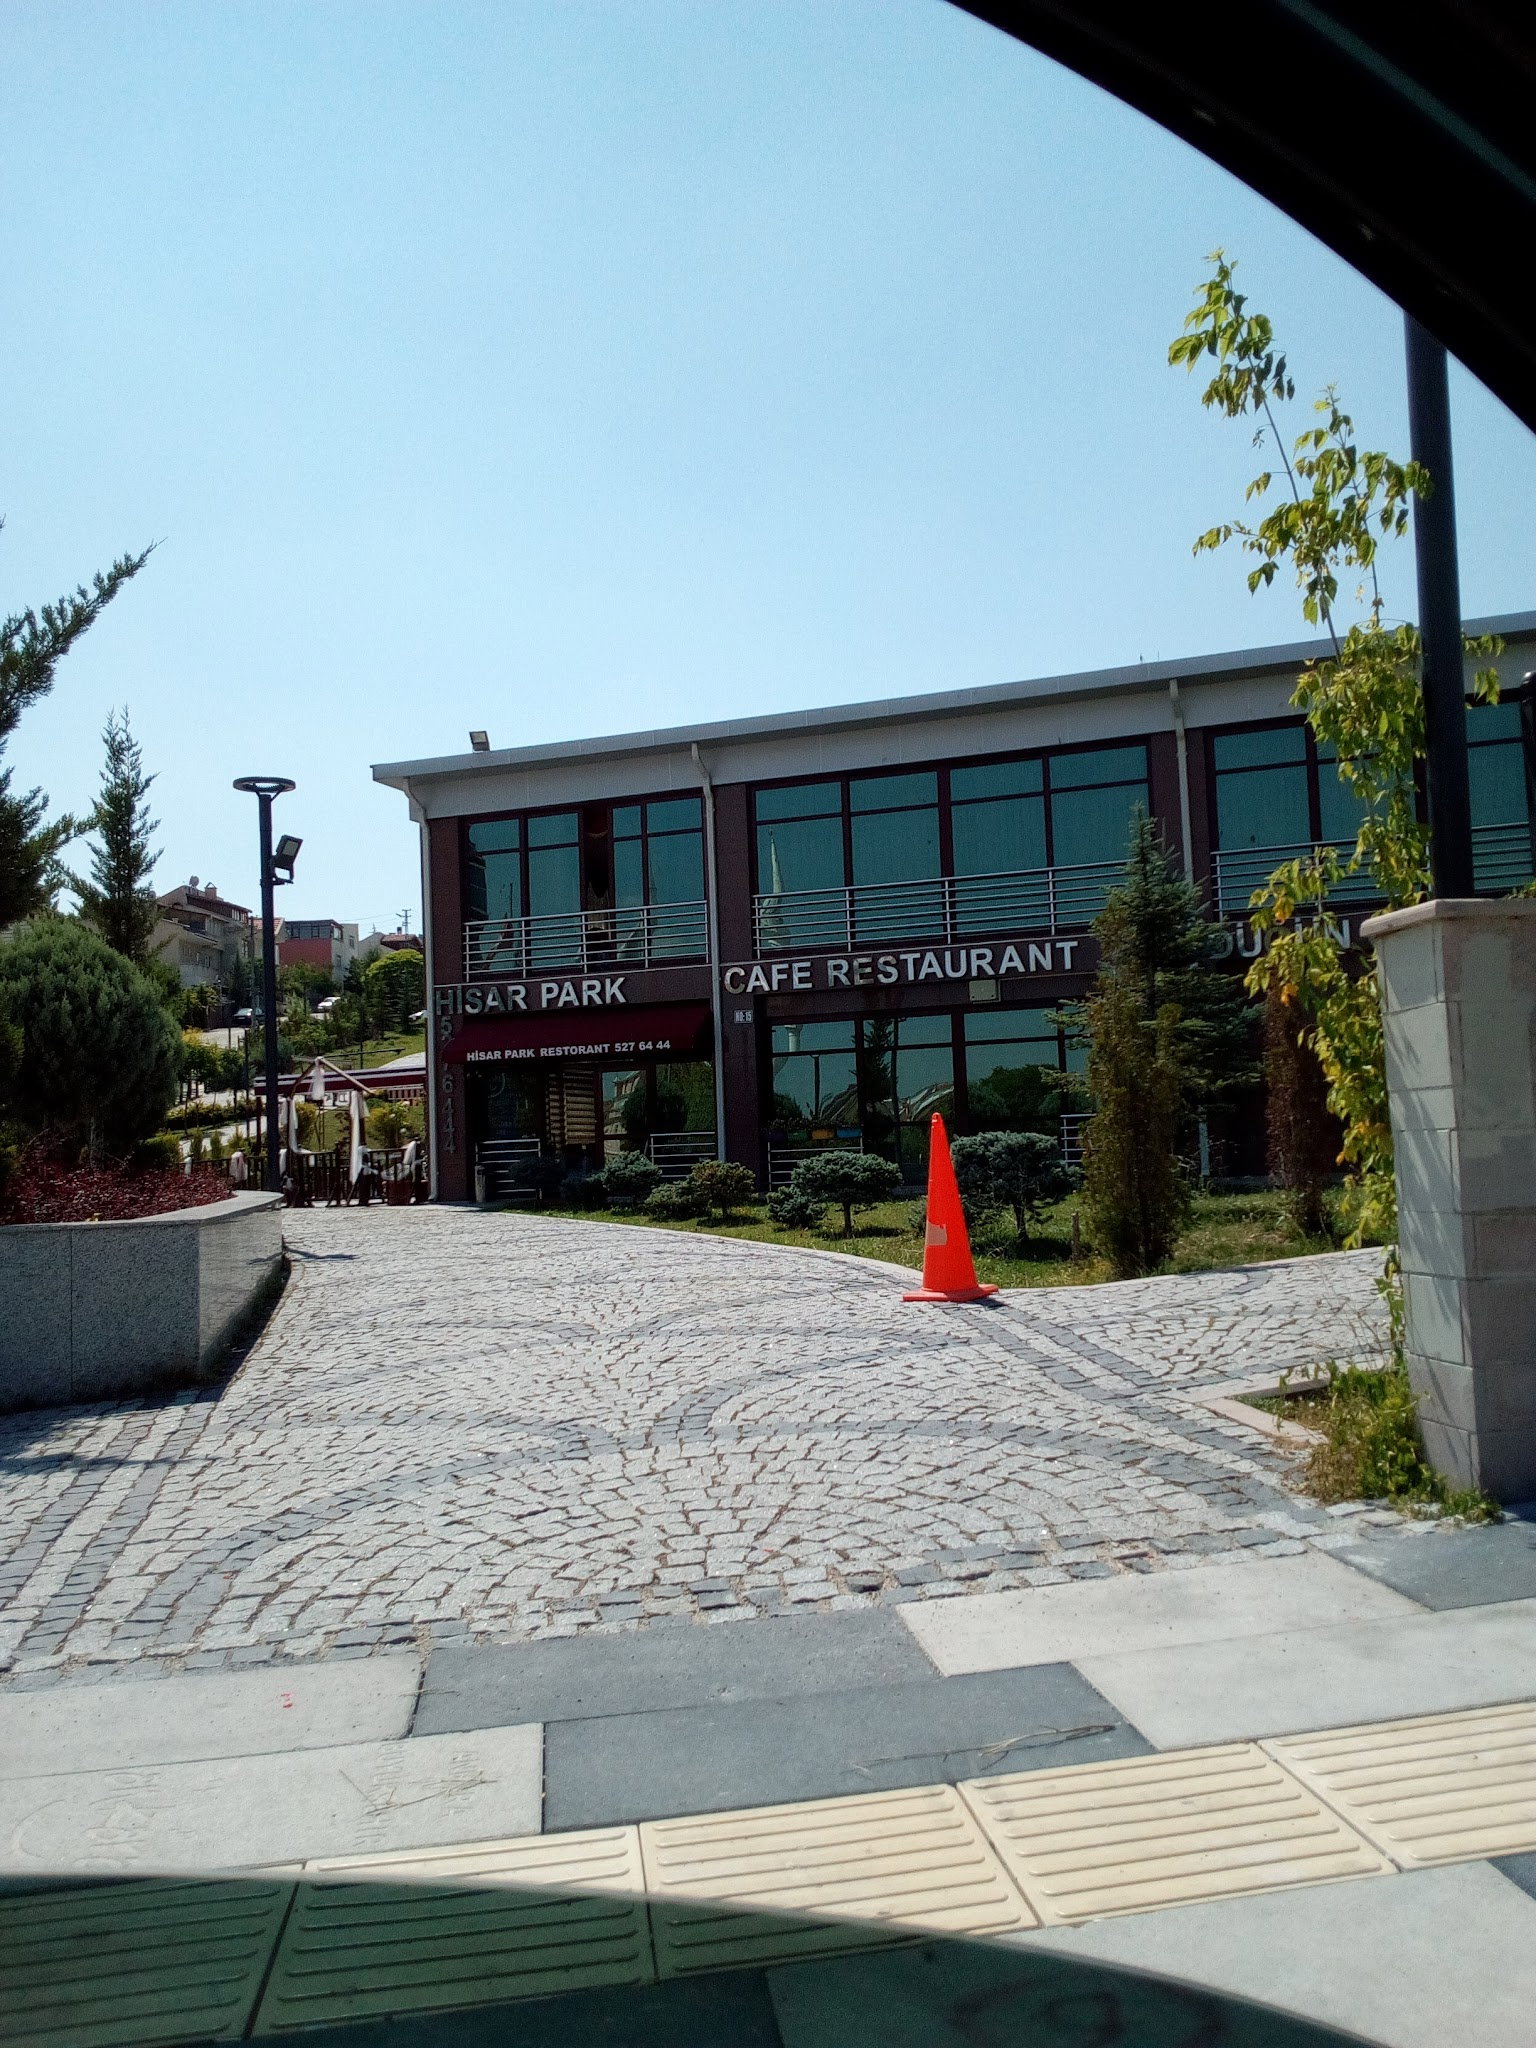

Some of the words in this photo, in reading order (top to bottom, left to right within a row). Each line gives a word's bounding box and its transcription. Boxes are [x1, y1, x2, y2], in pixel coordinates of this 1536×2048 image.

[1210, 917, 1350, 958] DÜN
[724, 961, 812, 994] CAFE
[827, 941, 1078, 987] RESTAURANT
[435, 983, 528, 1015] HİSAR
[540, 977, 627, 1008] PARK
[467, 1050, 502, 1061] HİSAR
[505, 1049, 535, 1059] PARK
[540, 1044, 610, 1057] RESTORANT
[615, 1042, 635, 1052] 527
[639, 1041, 653, 1051] 64
[656, 1040, 671, 1049] 44
